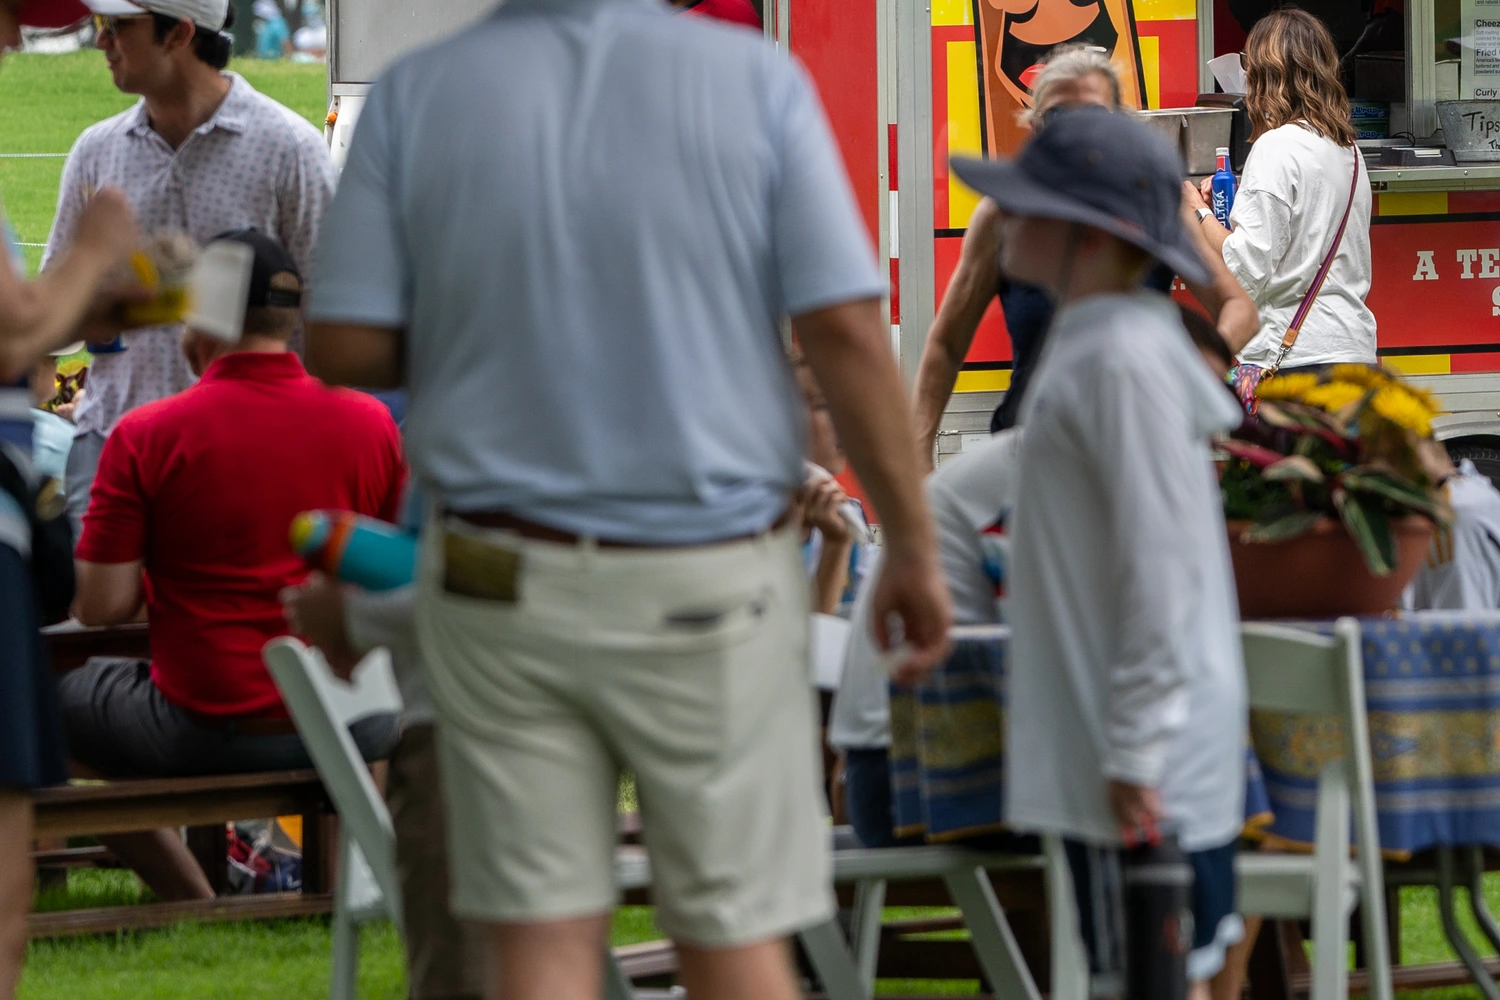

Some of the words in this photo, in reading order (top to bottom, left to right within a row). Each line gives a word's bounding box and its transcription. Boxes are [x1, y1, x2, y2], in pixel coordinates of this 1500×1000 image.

[1476, 48, 1497, 56] Fried
[1475, 88, 1497, 98] Curly
[1462, 112, 1500, 138] Tips
[1412, 250, 1439, 281] A
